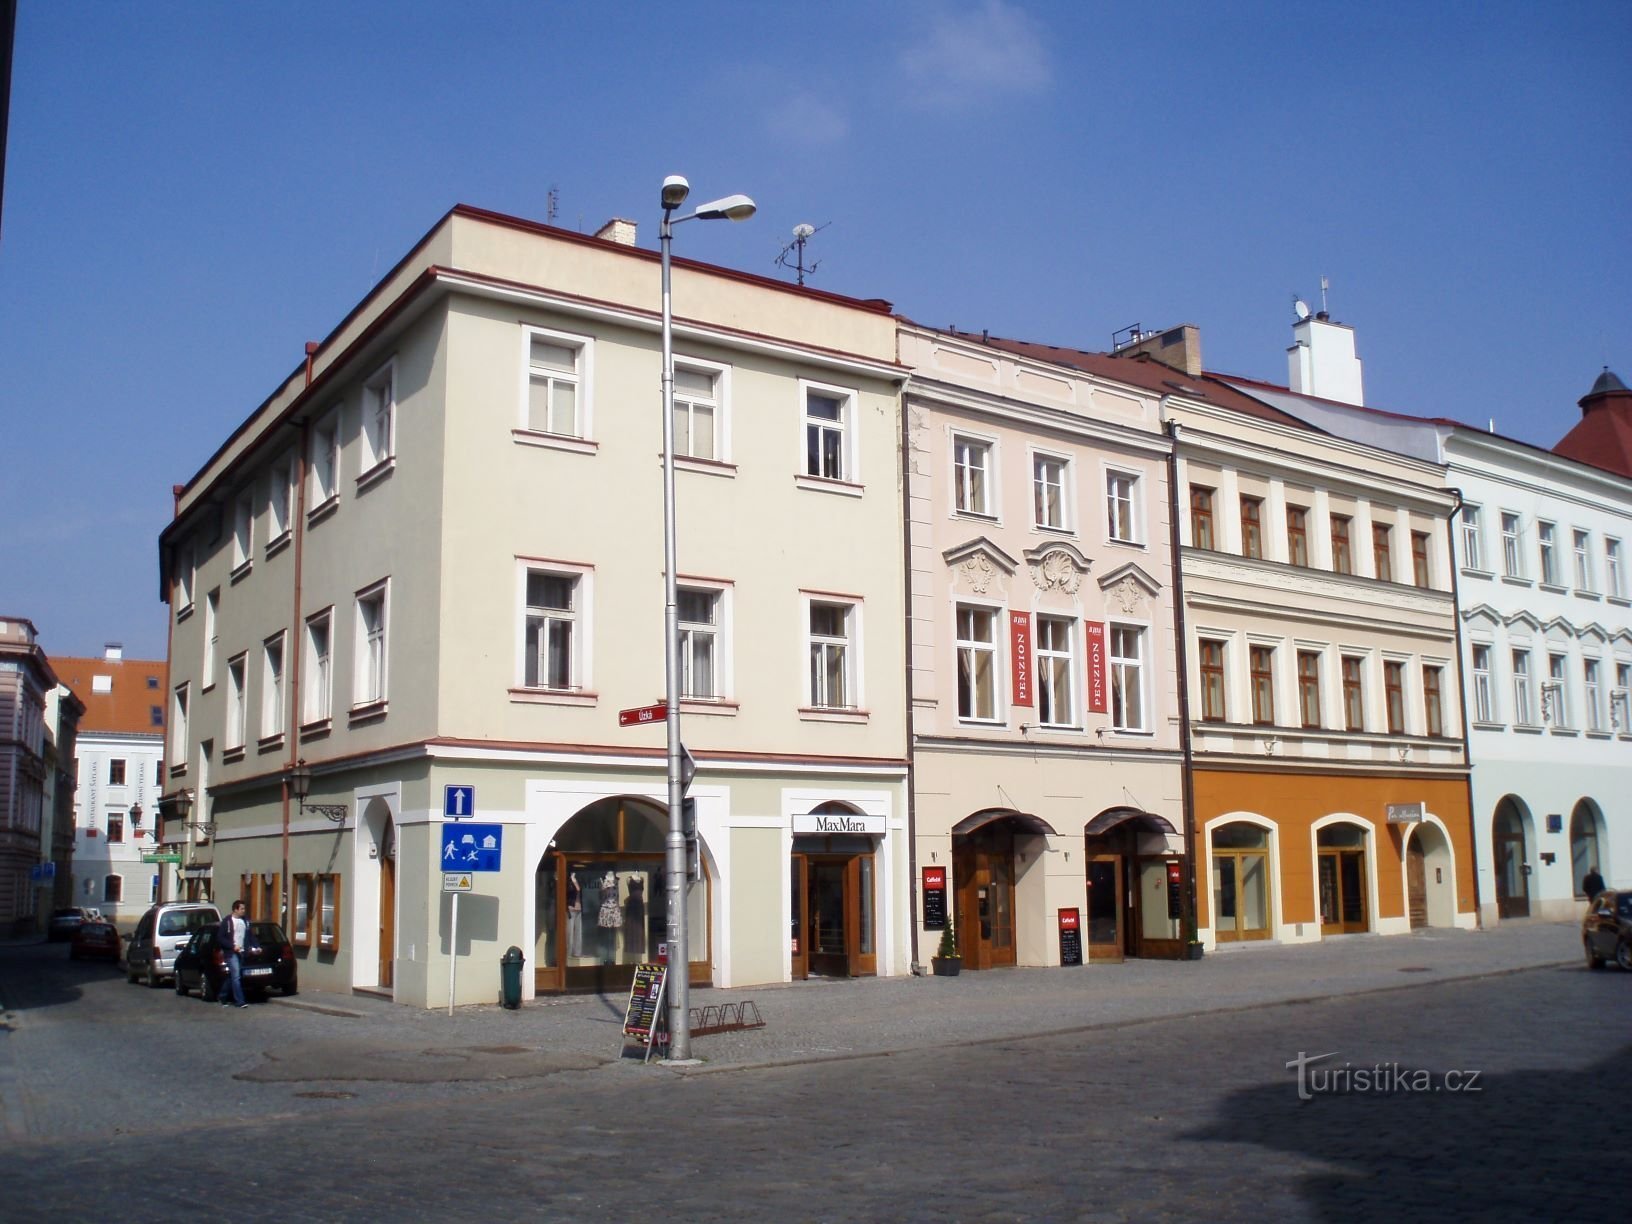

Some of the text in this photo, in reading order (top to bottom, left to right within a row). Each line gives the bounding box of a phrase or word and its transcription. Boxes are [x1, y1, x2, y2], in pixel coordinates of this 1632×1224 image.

[1017, 633, 1026, 699] PENZION
[1092, 642, 1102, 706] PENZION
[816, 817, 866, 832] MaxMara
